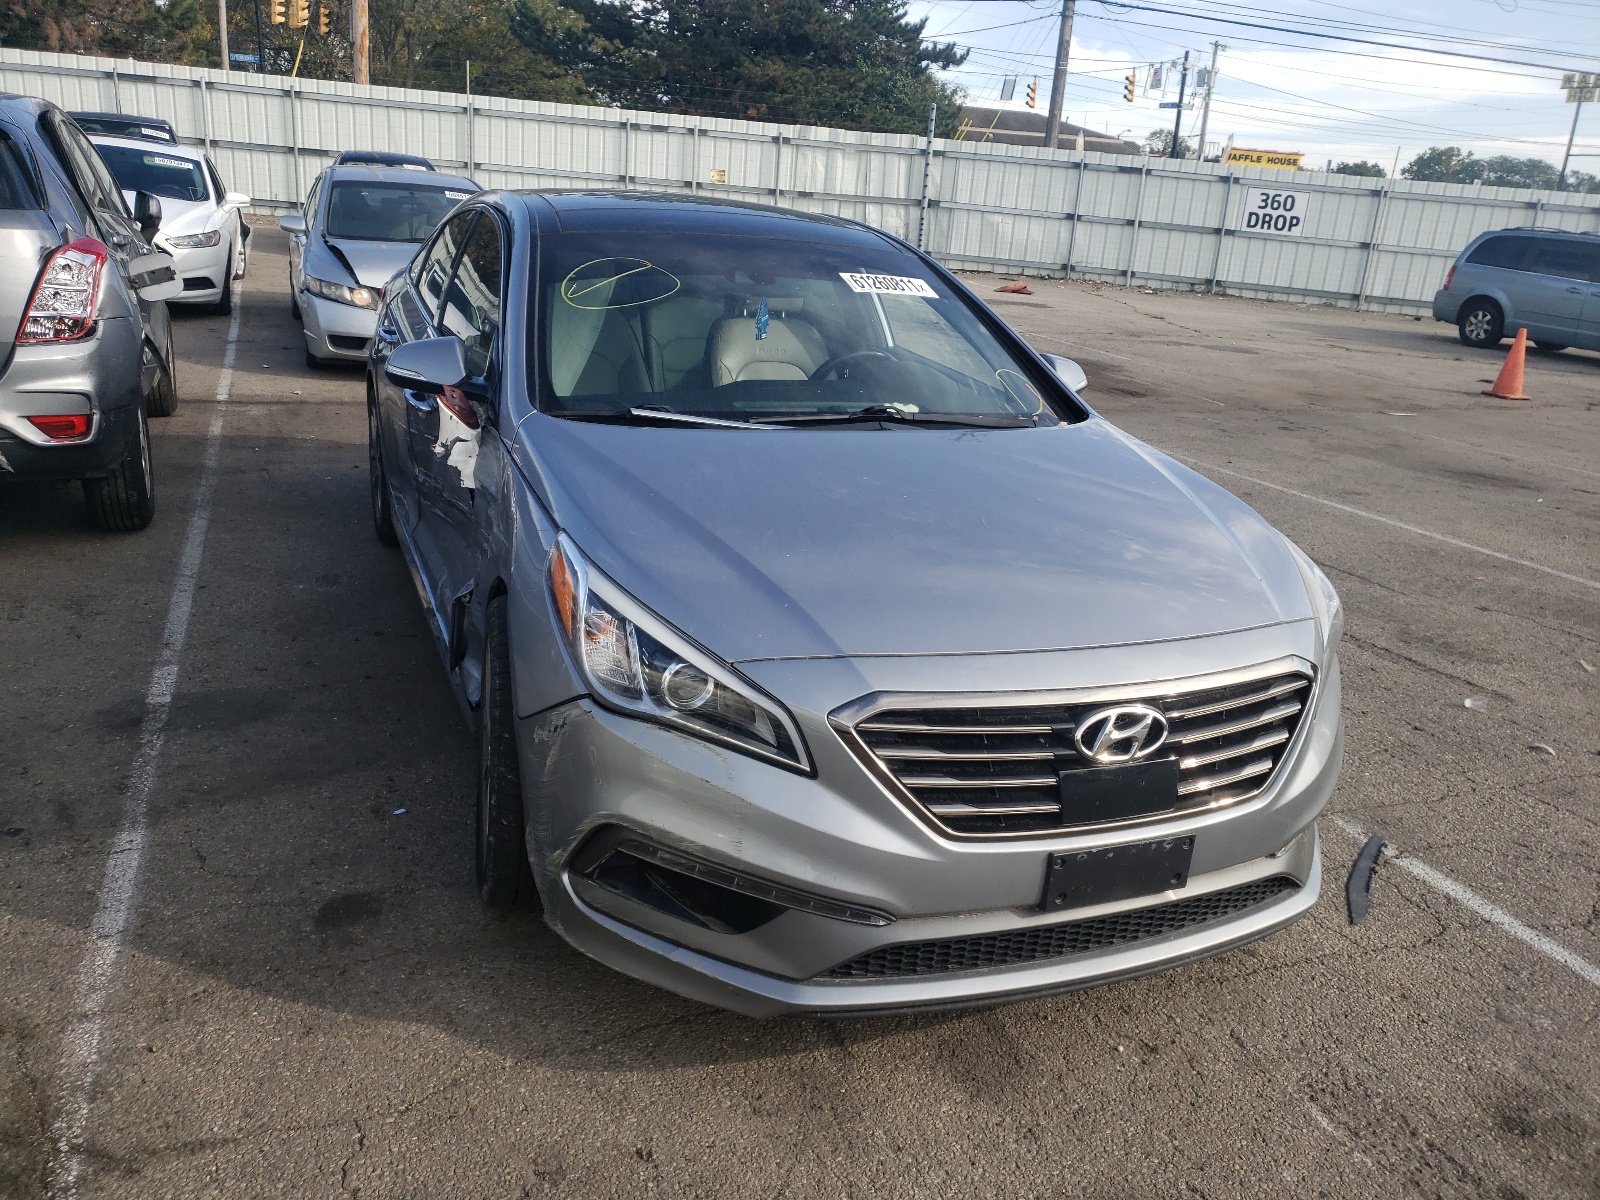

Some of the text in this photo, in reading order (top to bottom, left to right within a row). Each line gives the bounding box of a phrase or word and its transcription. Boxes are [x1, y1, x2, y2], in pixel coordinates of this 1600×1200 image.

[1267, 156, 1298, 166] HOUSE
[1258, 192, 1295, 212] 360
[1246, 211, 1300, 232] DROP
[850, 274, 921, 293] 61260811
